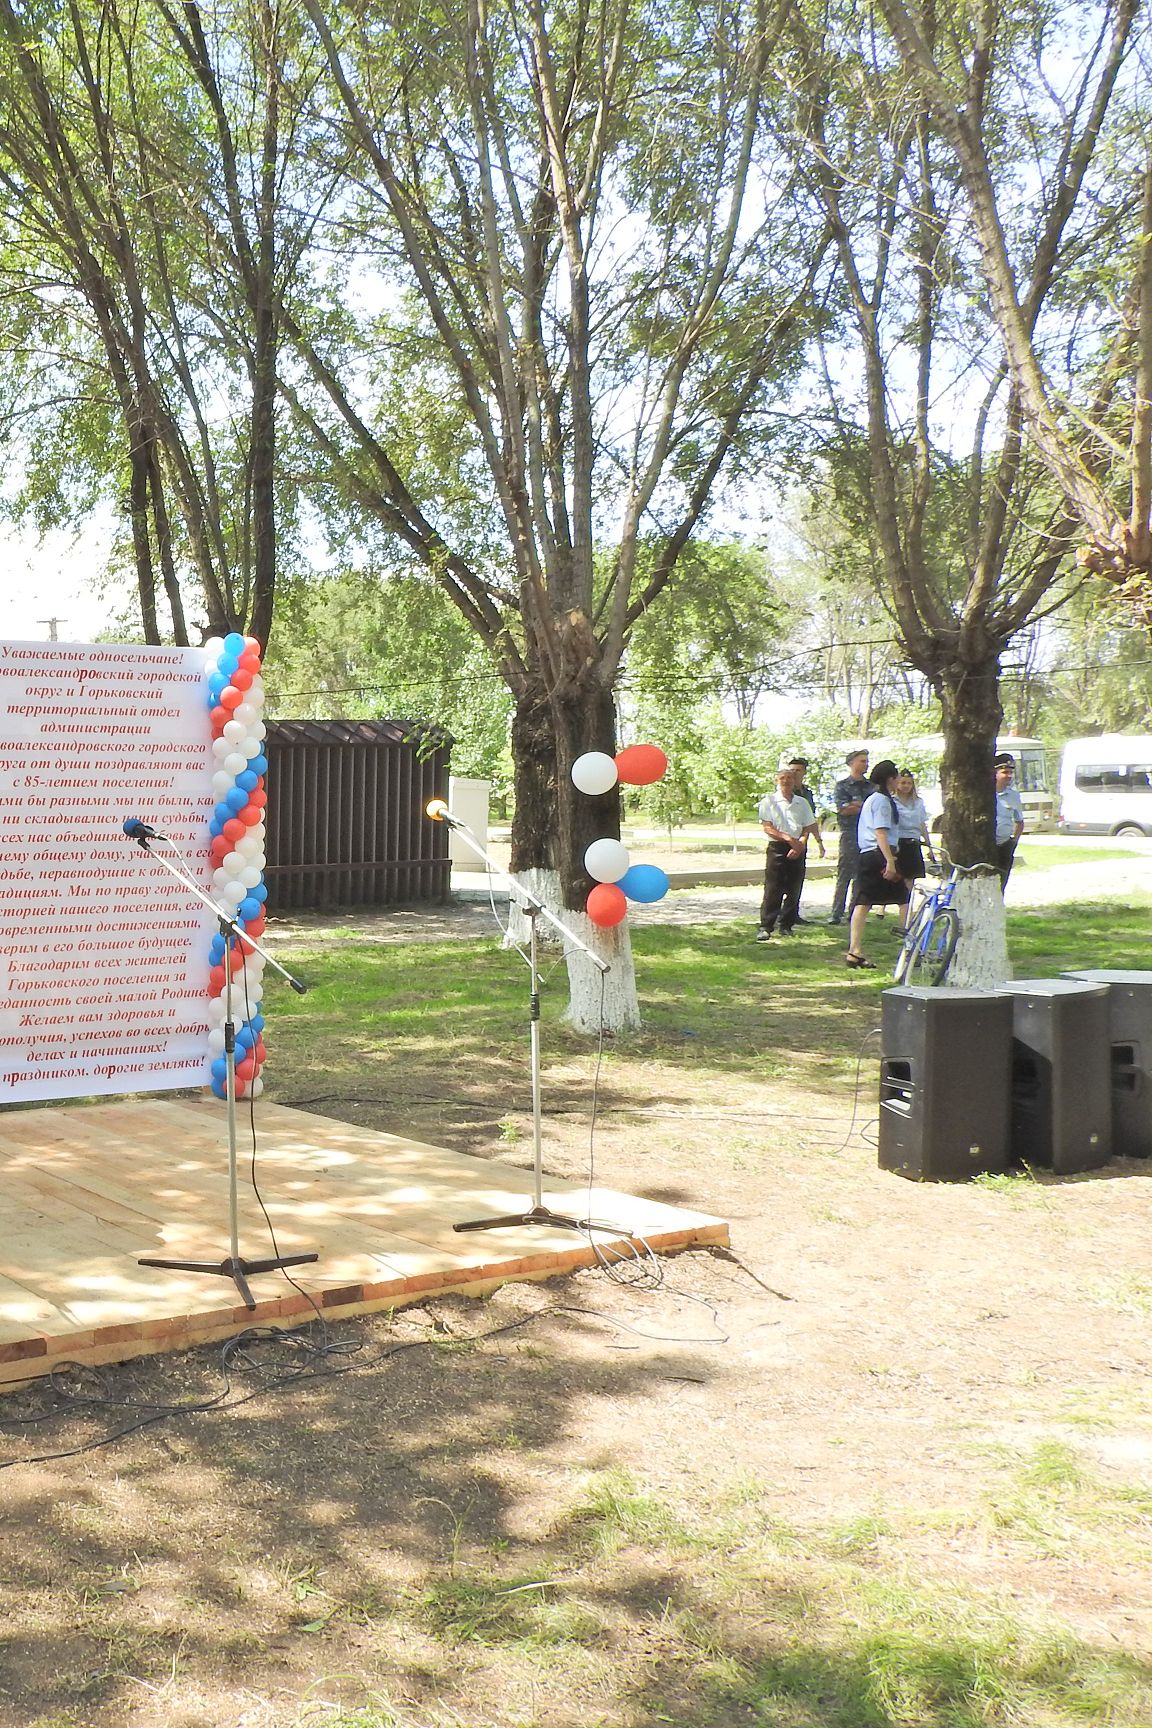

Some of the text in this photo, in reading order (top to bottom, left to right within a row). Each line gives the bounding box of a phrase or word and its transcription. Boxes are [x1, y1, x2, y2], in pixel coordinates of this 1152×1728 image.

[1, 646, 183, 664] Уважаемые односельчане!
[137, 670, 202, 683] городской
[25, 686, 62, 698] округ
[79, 685, 163, 700] Горьковский
[7, 703, 181, 717] территориальный отдел
[40, 722, 151, 736] администрации
[138, 743, 206, 754] городского
[54, 758, 90, 771] души
[95, 760, 182, 772] поздравляют
[186, 762, 205, 770] вас
[24, 775, 98, 788] 85-летием
[102, 776, 175, 788] поселения!
[49, 797, 109, 808] разными
[24, 812, 118, 825] складывались
[162, 812, 208, 825] судьбы,
[27, 832, 51, 843] нас
[33, 849, 87, 862] общему
[39, 869, 134, 880] неравнодушие
[114, 886, 151, 898] праву
[60, 905, 109, 916] нашего
[186, 902, 203, 910] его
[53, 943, 73, 952] его
[78, 940, 134, 951] большое
[138, 937, 192, 948] будущее.
[8, 954, 187, 973] Благодарим всех жителей
[8, 976, 100, 992] Горьковского
[104, 972, 170, 986] поселения
[75, 992, 112, 1005] своей
[116, 992, 157, 1003] малой
[161, 988, 208, 1000] Родине.
[19, 1014, 74, 1026] Желаем
[79, 1013, 103, 1023] вам
[108, 1009, 164, 1021] здоровья
[70, 1030, 122, 1044] успехов
[144, 1026, 170, 1036] всех
[27, 1050, 65, 1063] делах
[82, 1041, 167, 1058] начинаниях!
[93, 1063, 144, 1079] дорогие
[148, 1056, 205, 1071] земляки!
